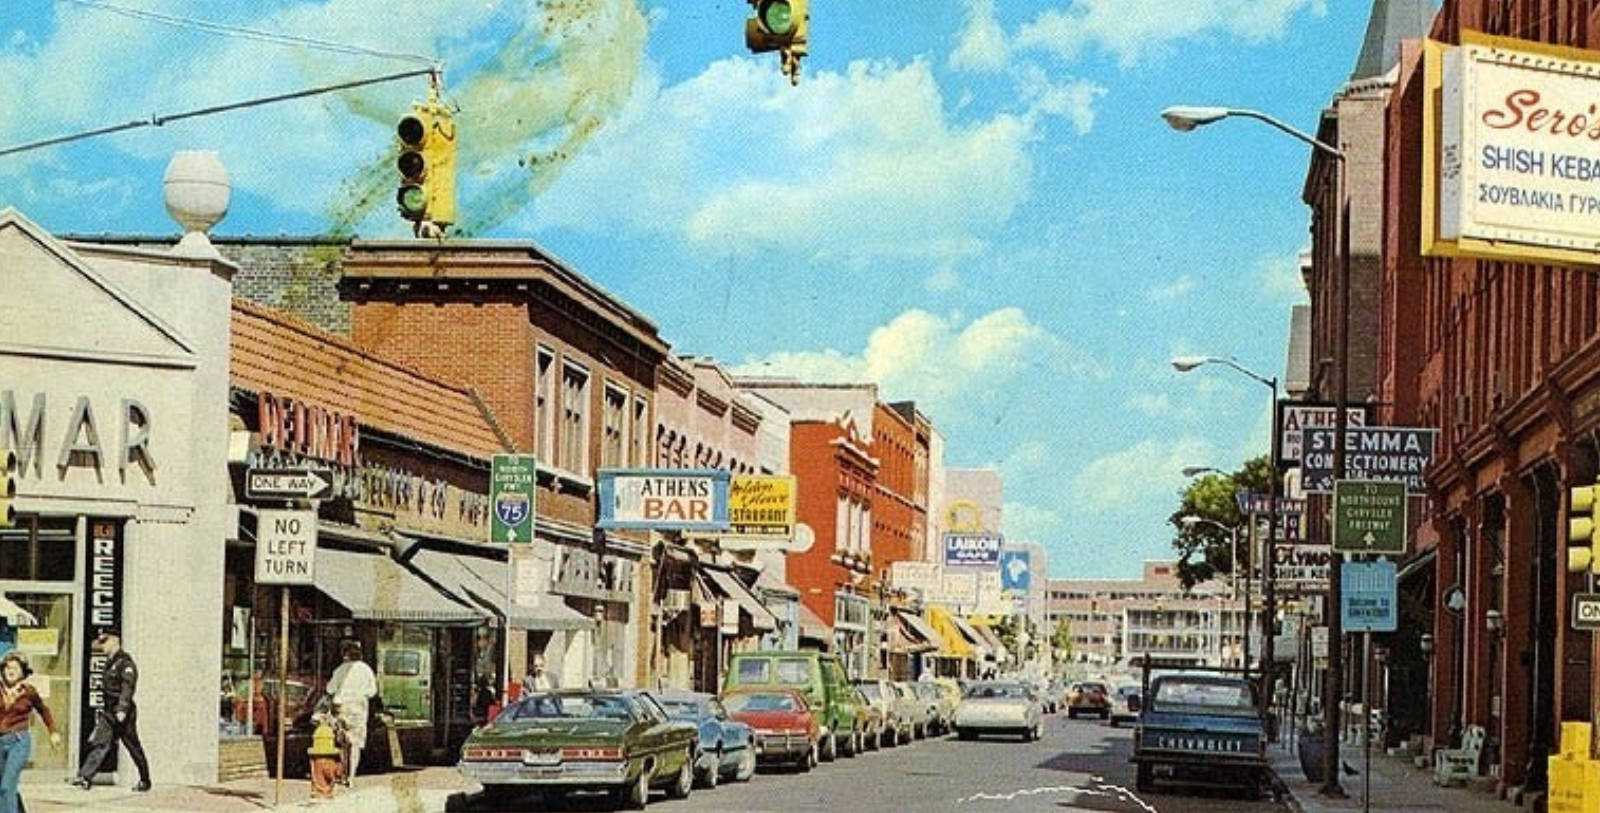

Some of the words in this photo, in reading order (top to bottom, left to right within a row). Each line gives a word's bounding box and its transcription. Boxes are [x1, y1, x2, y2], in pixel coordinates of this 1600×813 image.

[1482, 144, 1544, 175] SHISH
[1478, 183, 1564, 212] ΣΟΥΒΛΑΚΙΑ
[1286, 409, 1361, 431] ATHES
[1312, 431, 1421, 452] STEMMA
[1305, 452, 1429, 472] CONECTIONERY
[253, 476, 281, 489] ONE
[288, 477, 318, 490] WAY
[641, 478, 709, 497] ATHENS
[1364, 485, 1378, 495] TO
[501, 505, 522, 521] 75
[644, 498, 709, 520] BAR
[274, 519, 301, 535] NO
[267, 541, 307, 555] LEFT
[265, 559, 309, 575] TURN
[1158, 736, 1241, 751] CHEVROLET
